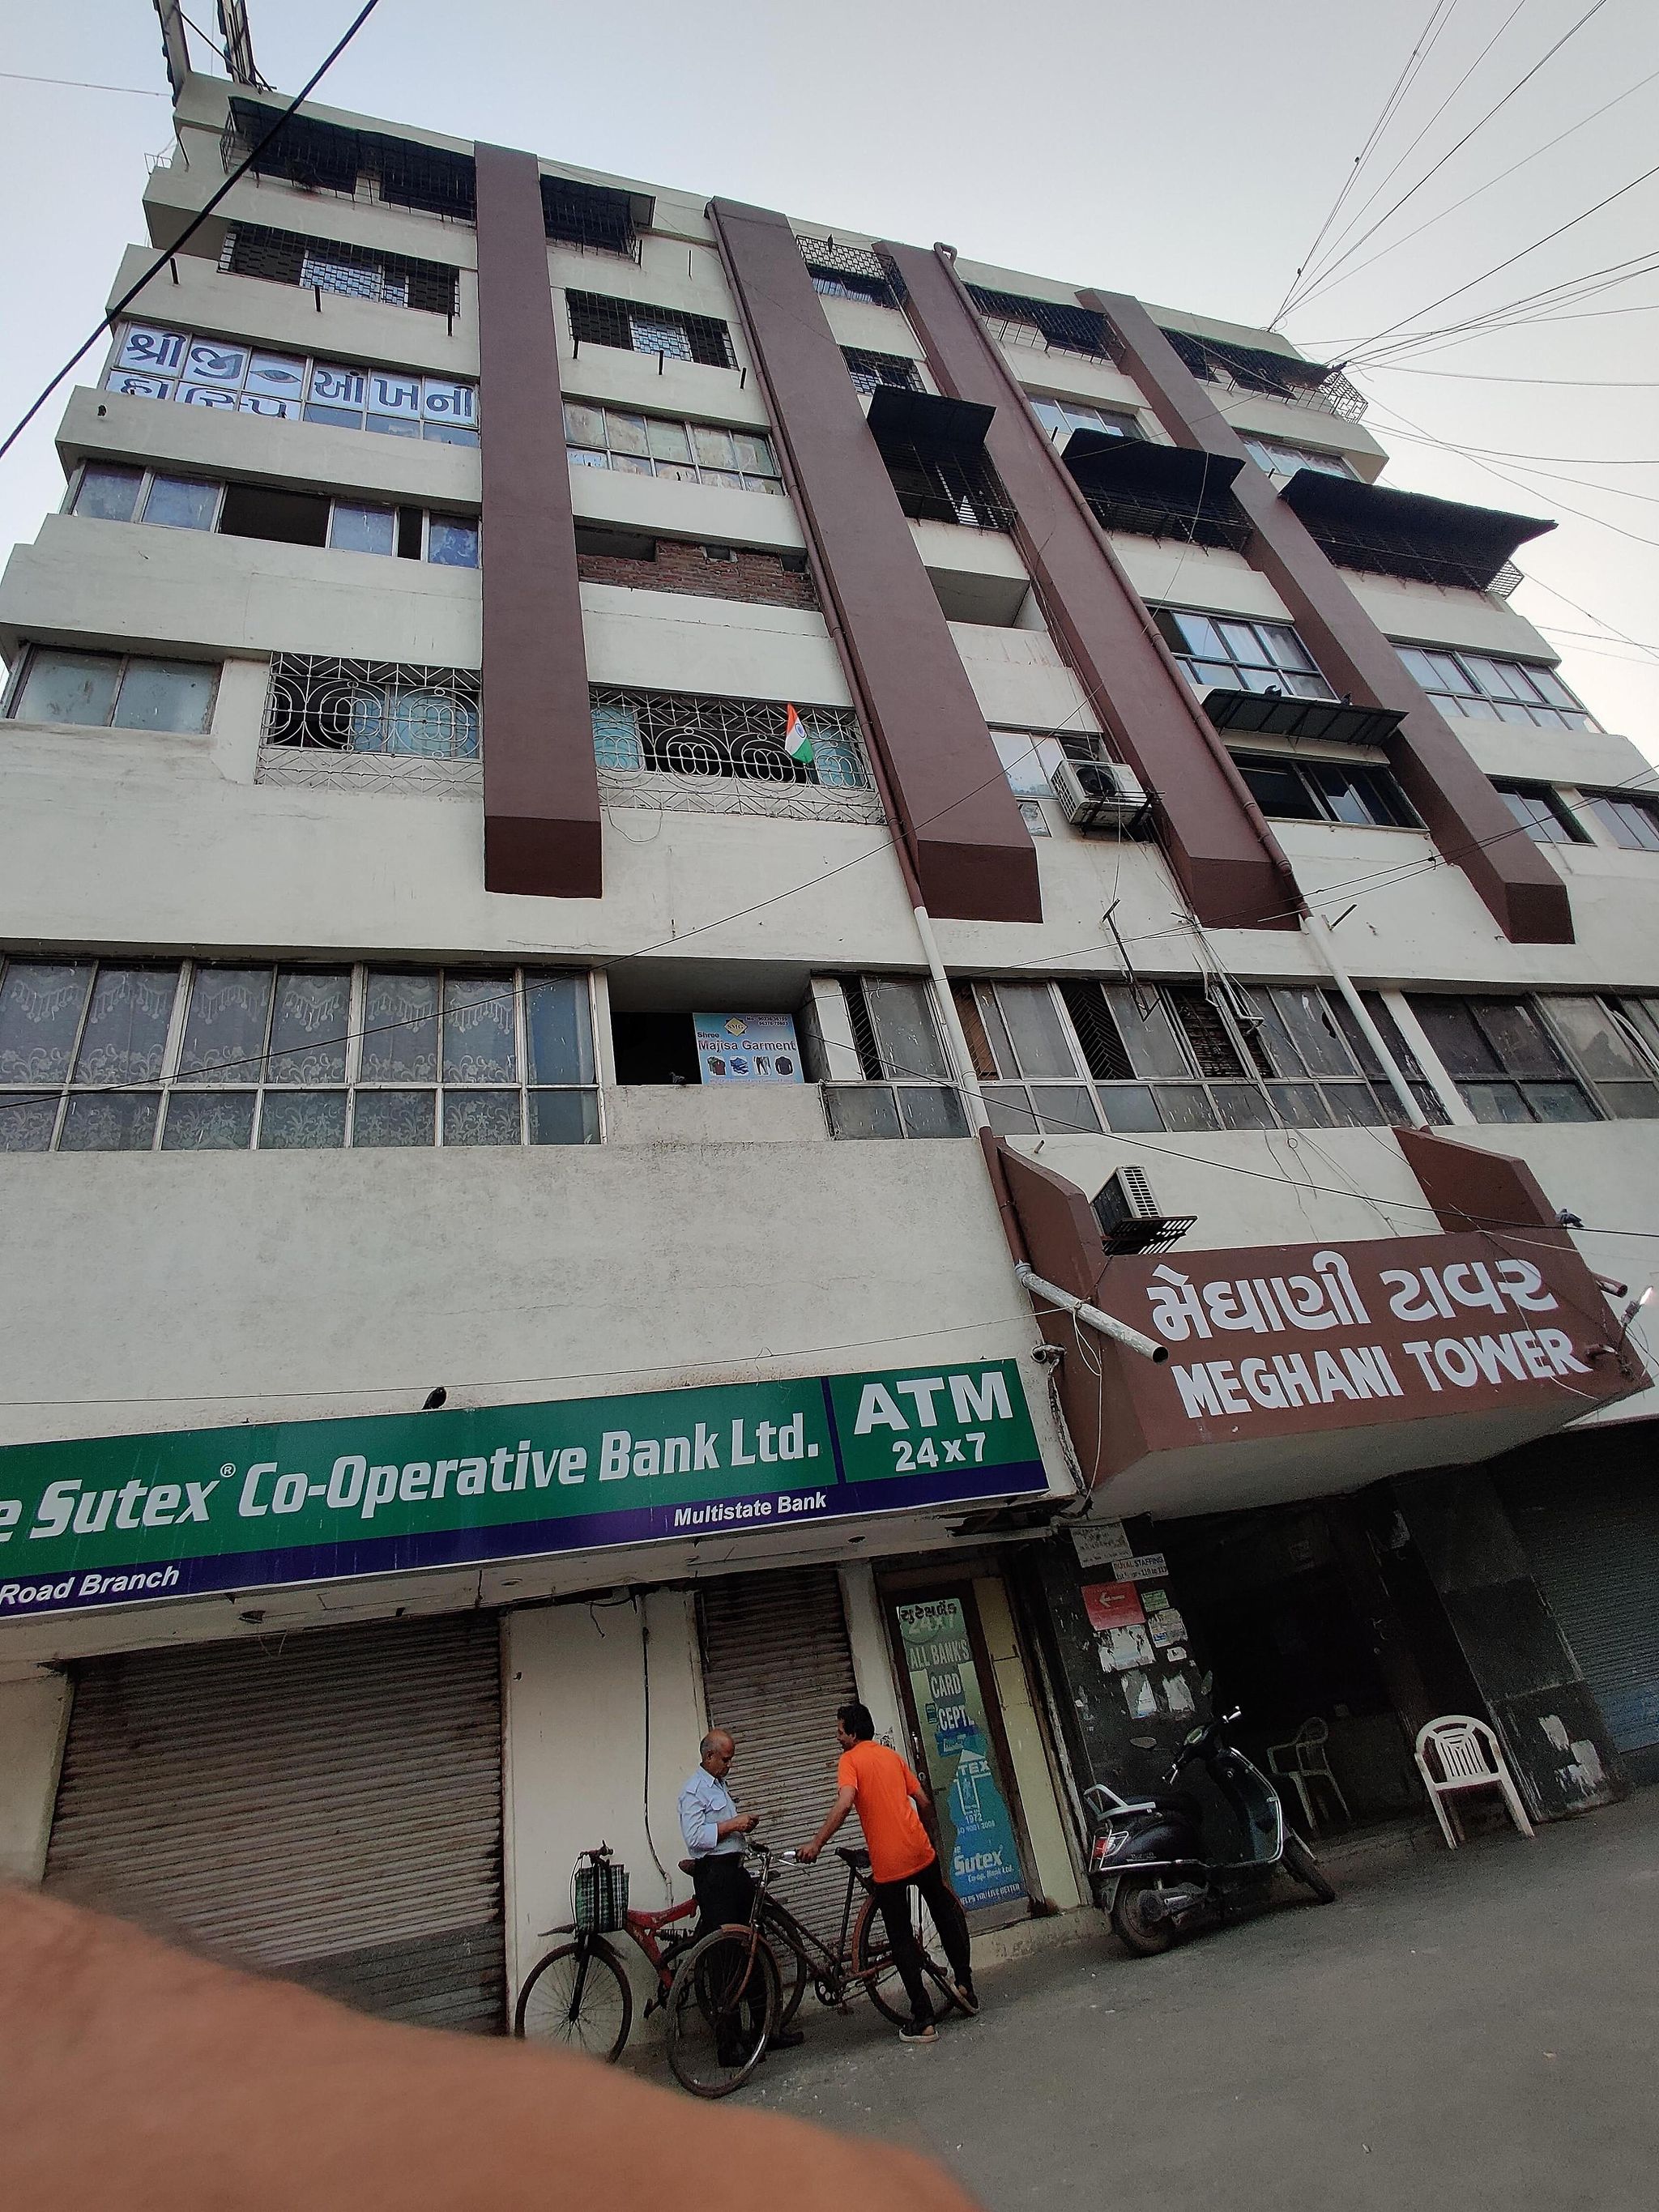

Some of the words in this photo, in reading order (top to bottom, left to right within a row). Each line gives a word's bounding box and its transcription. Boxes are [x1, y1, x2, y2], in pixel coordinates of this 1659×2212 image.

[697, 1040, 739, 1053] Majisa
[741, 1040, 797, 1051] Garment
[1146, 1250, 1372, 1341] મેઘાણી
[1379, 1259, 1559, 1323] ટાવર
[1171, 1345, 1405, 1418] MEGHANI
[1402, 1327, 1594, 1392] TOWER
[853, 1371, 1013, 1435] ATM
[238, 1440, 586, 1519] Co-Operative
[599, 1423, 720, 1481] Bank
[731, 1413, 819, 1467] Ltd.
[674, 1498, 772, 1527] Multistate
[778, 1491, 827, 1514] Bank
[1134, 1556, 1163, 1567] STAFFING
[0, 1576, 75, 1605] Road
[79, 1566, 180, 1597] Branch
[908, 1645, 931, 1669] ALL
[932, 1639, 970, 1665] BANK'S
[930, 1673, 962, 1698] CARD
